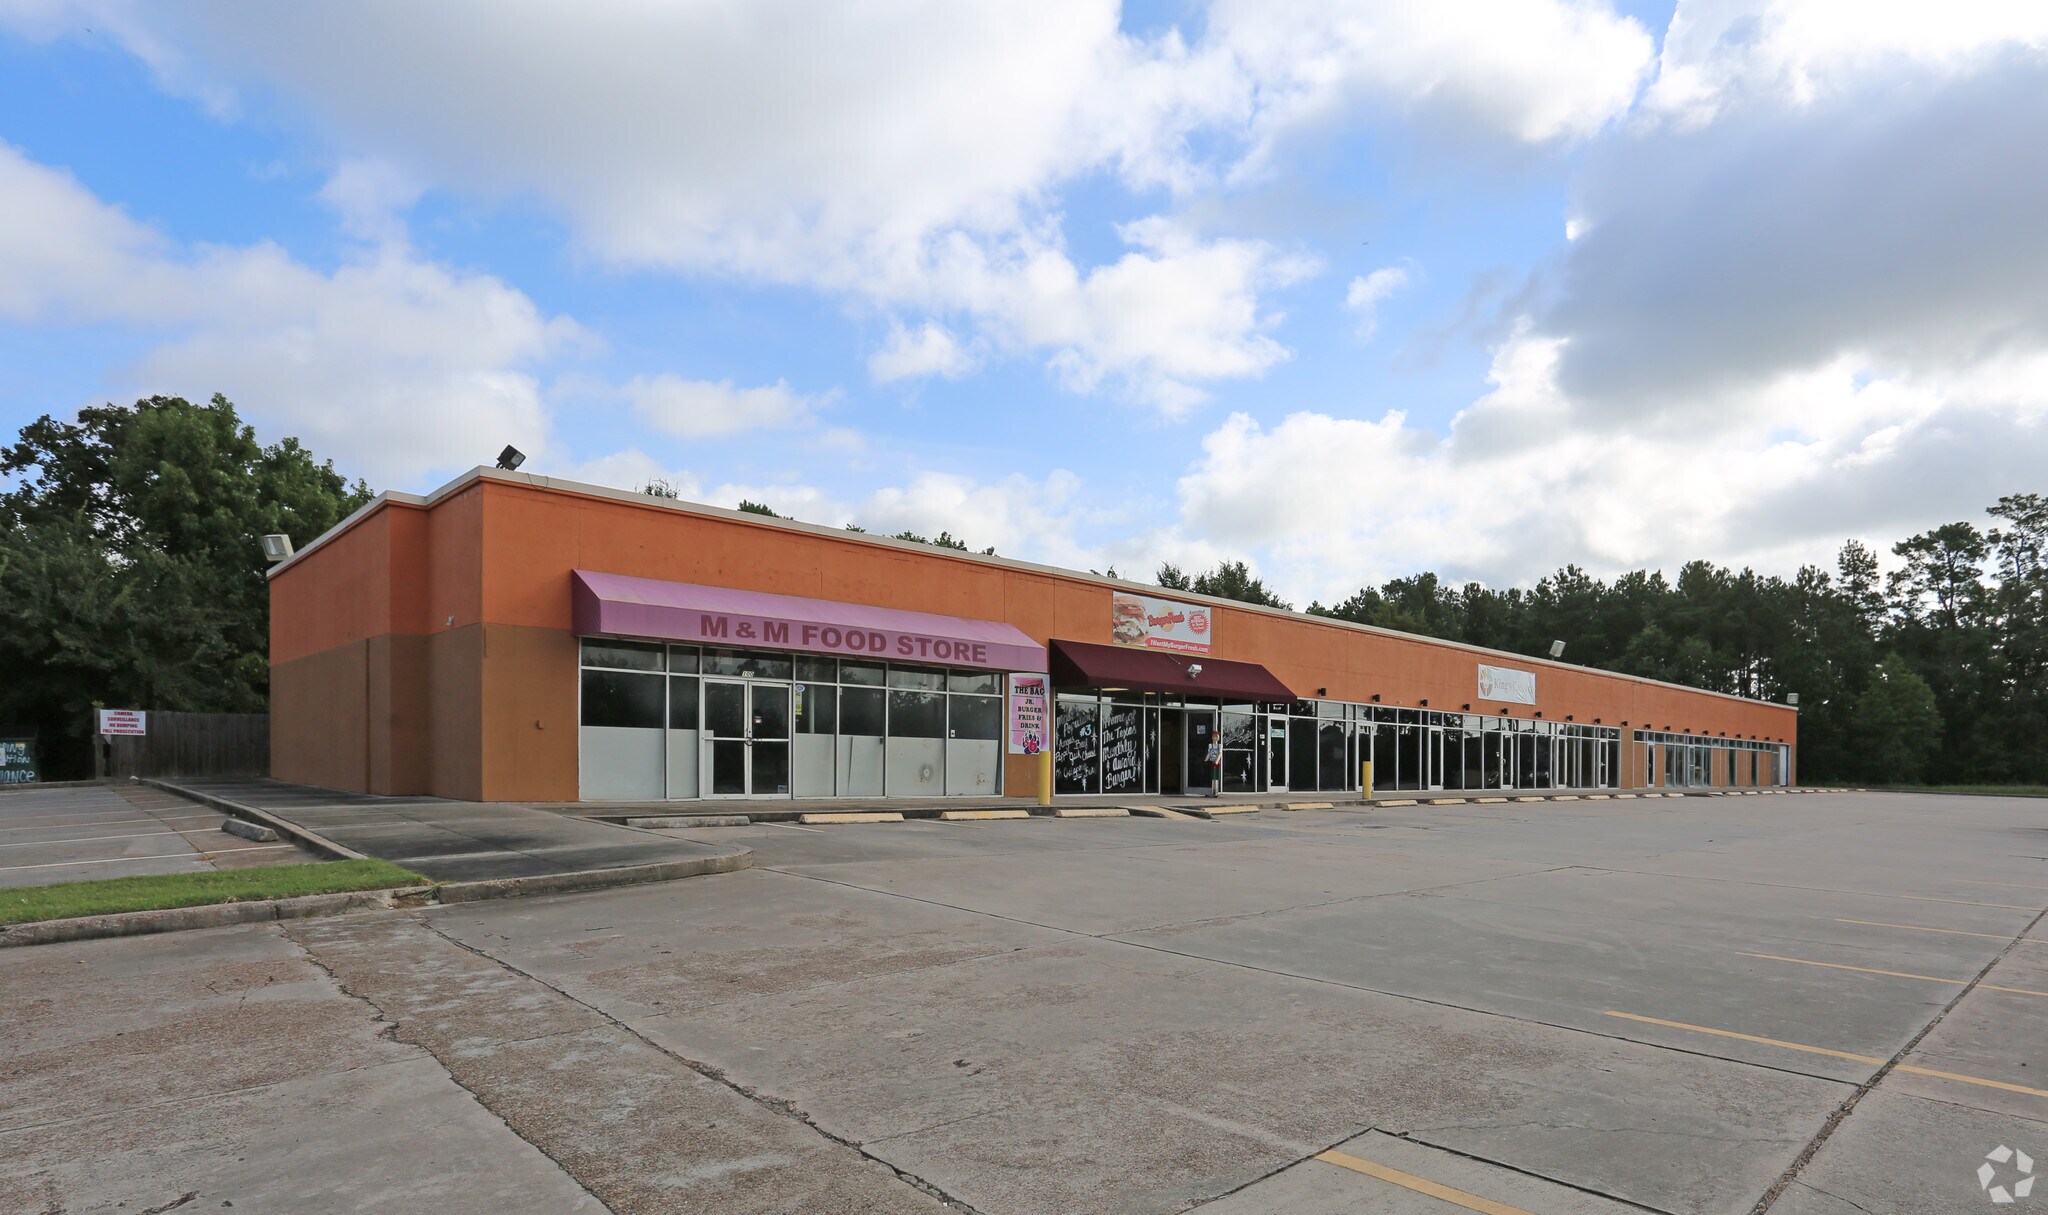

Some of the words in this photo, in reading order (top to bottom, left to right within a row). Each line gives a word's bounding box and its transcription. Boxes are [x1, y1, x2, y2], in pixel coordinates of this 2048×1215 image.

[701, 614, 728, 639] M
[735, 621, 756, 639] &
[763, 621, 789, 644] M
[802, 624, 887, 653] FOOD
[897, 635, 987, 663] STORE
[1014, 686, 1028, 695] THE
[1030, 686, 1045, 696] BAG
[1080, 724, 1092, 737] #3
[1103, 730, 1114, 745] The
[1114, 725, 1137, 739] Texas
